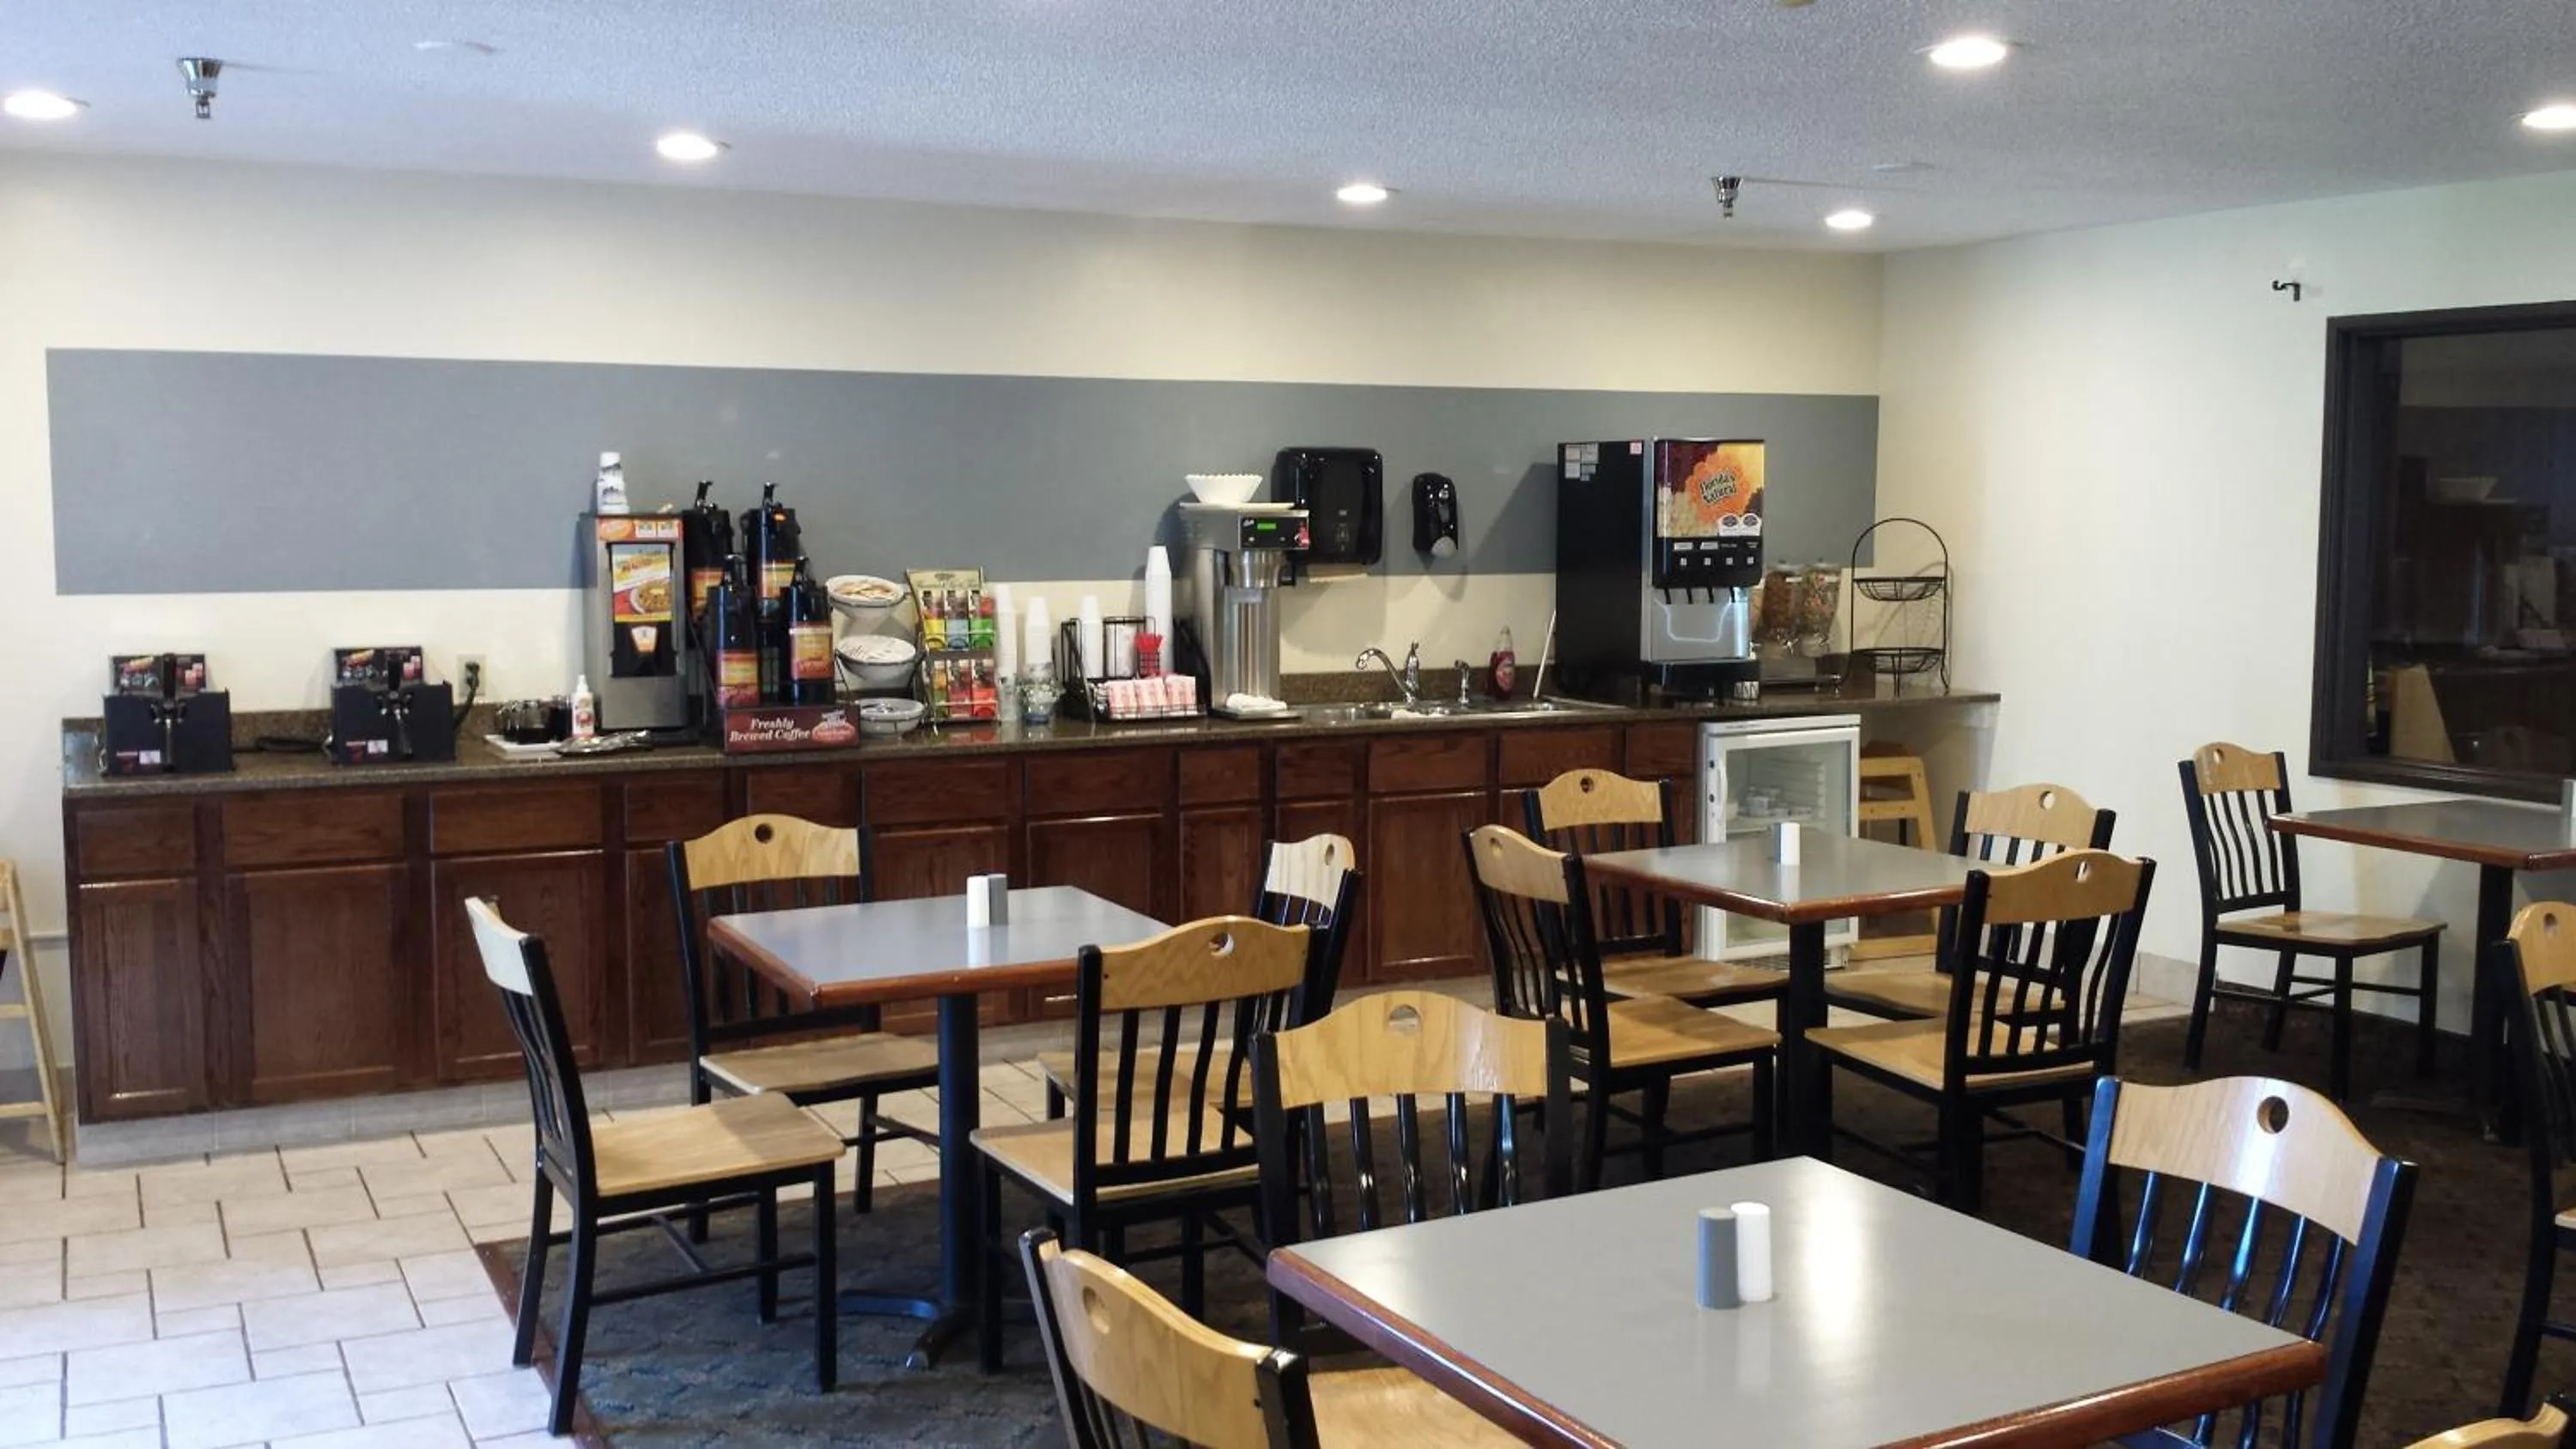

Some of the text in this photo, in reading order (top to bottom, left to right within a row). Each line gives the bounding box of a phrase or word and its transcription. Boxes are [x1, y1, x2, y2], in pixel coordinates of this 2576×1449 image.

[750, 718, 794, 730] Freshly
[730, 729, 811, 742] Brewed Coffee
